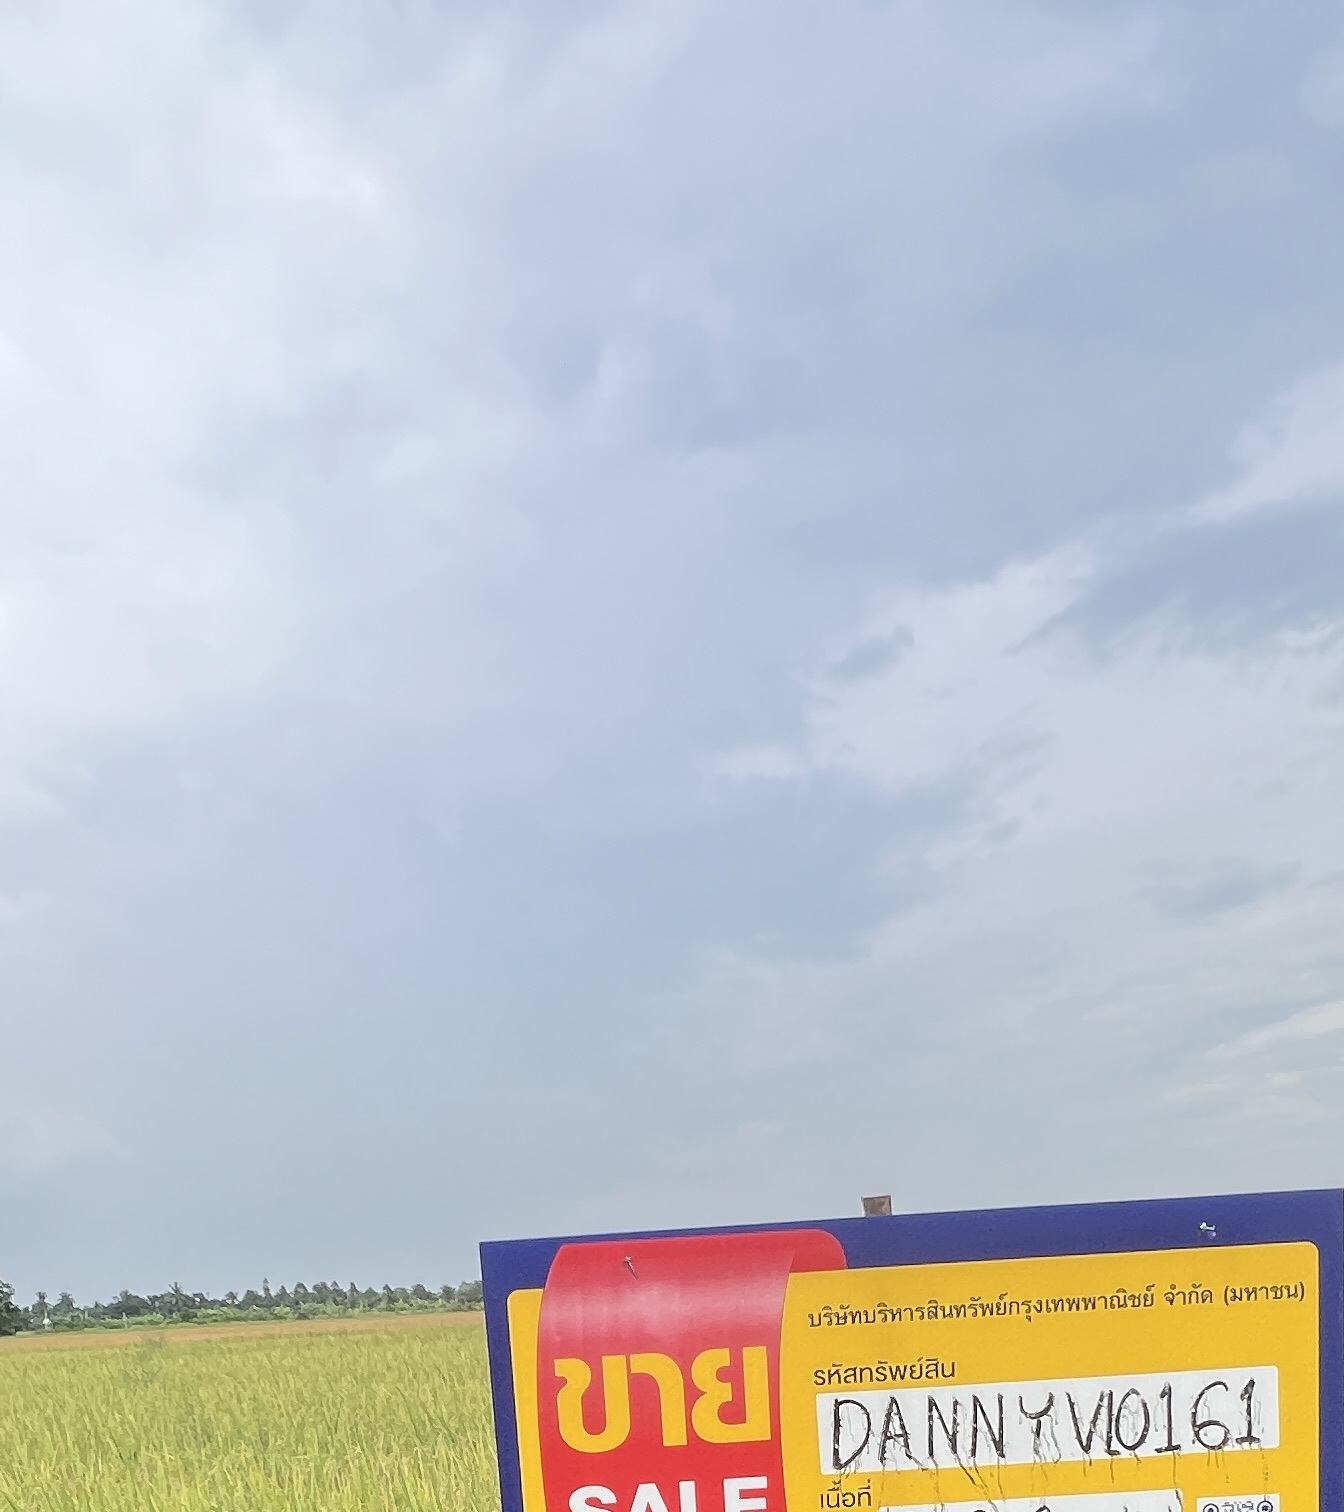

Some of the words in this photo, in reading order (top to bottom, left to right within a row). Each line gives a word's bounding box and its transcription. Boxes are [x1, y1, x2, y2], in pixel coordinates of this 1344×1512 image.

[807, 1284, 1156, 1329] บริษัทบริหารสินทรัพย์กรุงเทพพาณิชย์
[1163, 1281, 1214, 1306] จำกัด
[1222, 1281, 1306, 1306] (มหาชน)
[812, 1358, 957, 1387] รหัสทรัพย์สิน
[554, 1345, 773, 1455] ขาย
[819, 1477, 873, 1510] เนื้อที่
